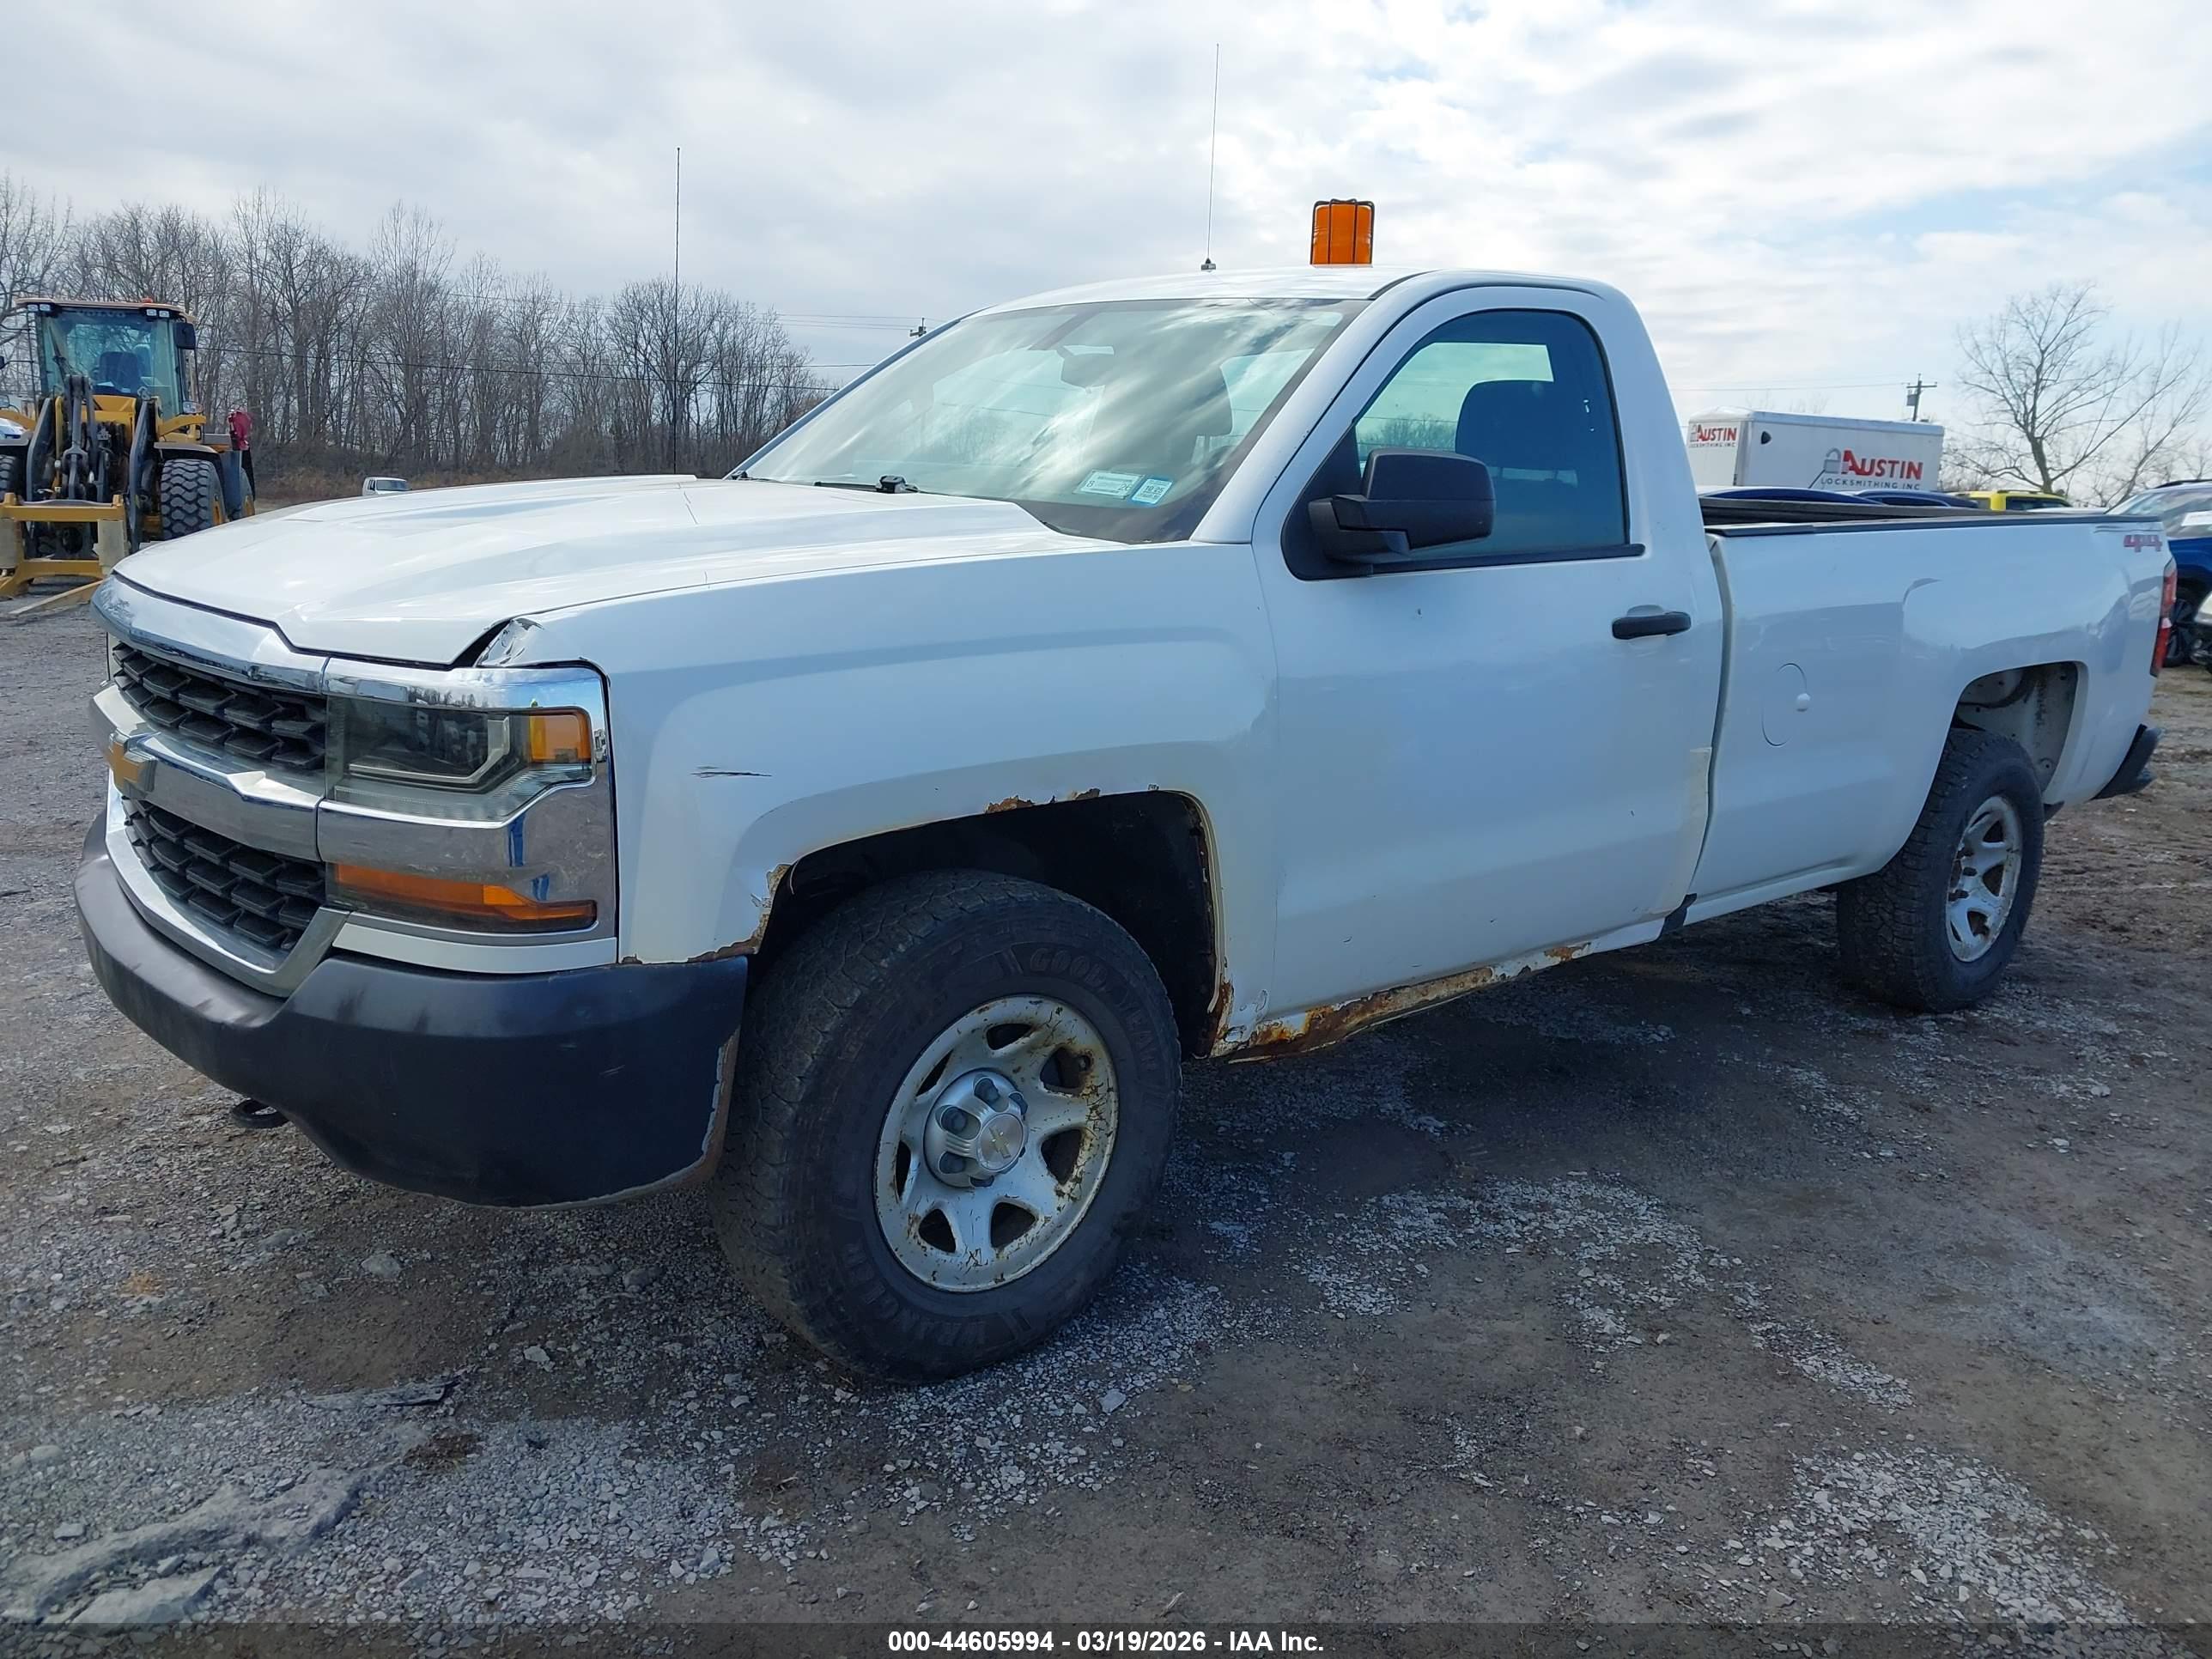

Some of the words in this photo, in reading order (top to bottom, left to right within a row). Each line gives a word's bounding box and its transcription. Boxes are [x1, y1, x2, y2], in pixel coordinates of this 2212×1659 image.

[1696, 424, 1737, 441] AUSTIN
[1841, 449, 1923, 480] AUSTIN
[1820, 477, 1898, 489] LOCKSMITHING
